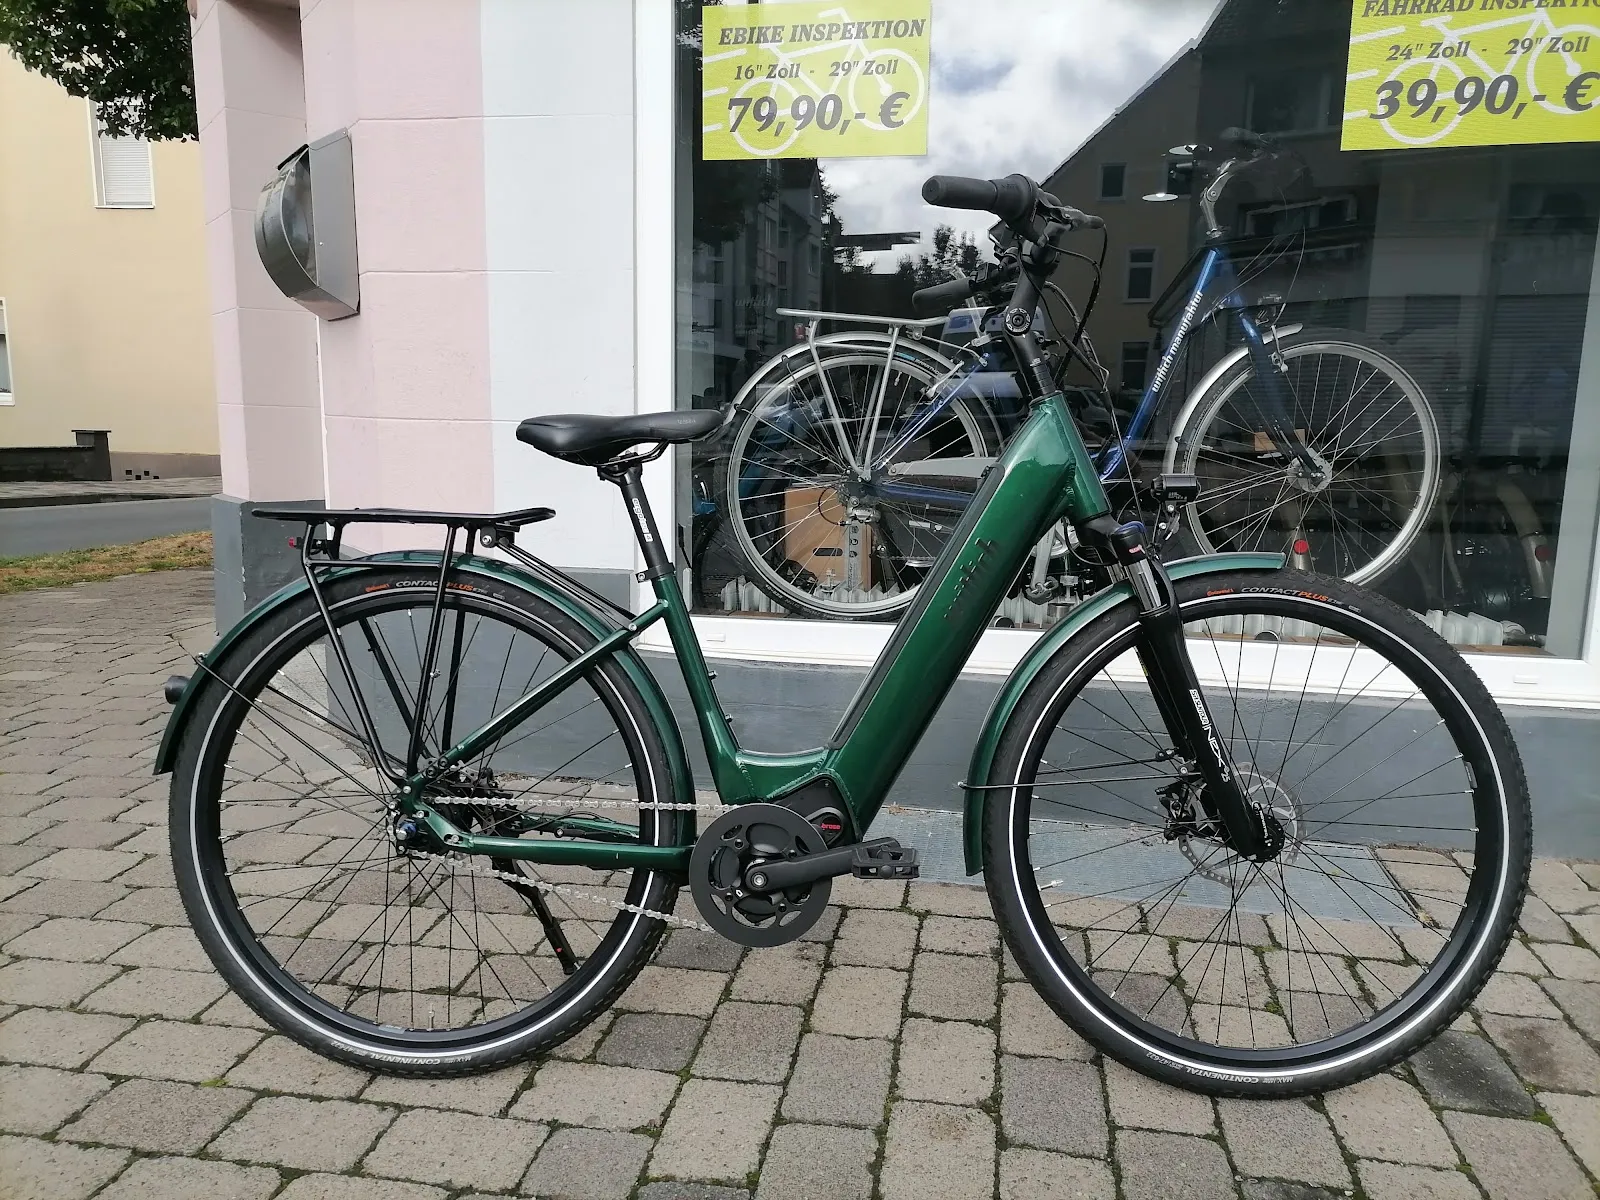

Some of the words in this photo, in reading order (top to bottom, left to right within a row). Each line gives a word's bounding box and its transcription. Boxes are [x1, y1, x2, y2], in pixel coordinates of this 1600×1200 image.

[1362, 0, 1474, 17] FAHRRAD
[718, 25, 785, 45] EBIKE
[788, 18, 926, 43] INSPEKTION
[1386, 43, 1423, 61] 24"
[1427, 41, 1470, 59] Zoll
[1505, 37, 1542, 55] 29"
[1547, 36, 1591, 54] Zoll
[734, 64, 762, 80] 16"
[766, 63, 800, 79] Zoll
[829, 61, 858, 77] 29"
[862, 59, 899, 76] Zoll
[1562, 71, 1600, 112] €
[878, 91, 911, 129] €
[1169, 289, 1204, 355] manufaktur
[370, 1054, 441, 1065] CONTINENTAL
[1185, 1067, 1259, 1084] CONTINENTAL
